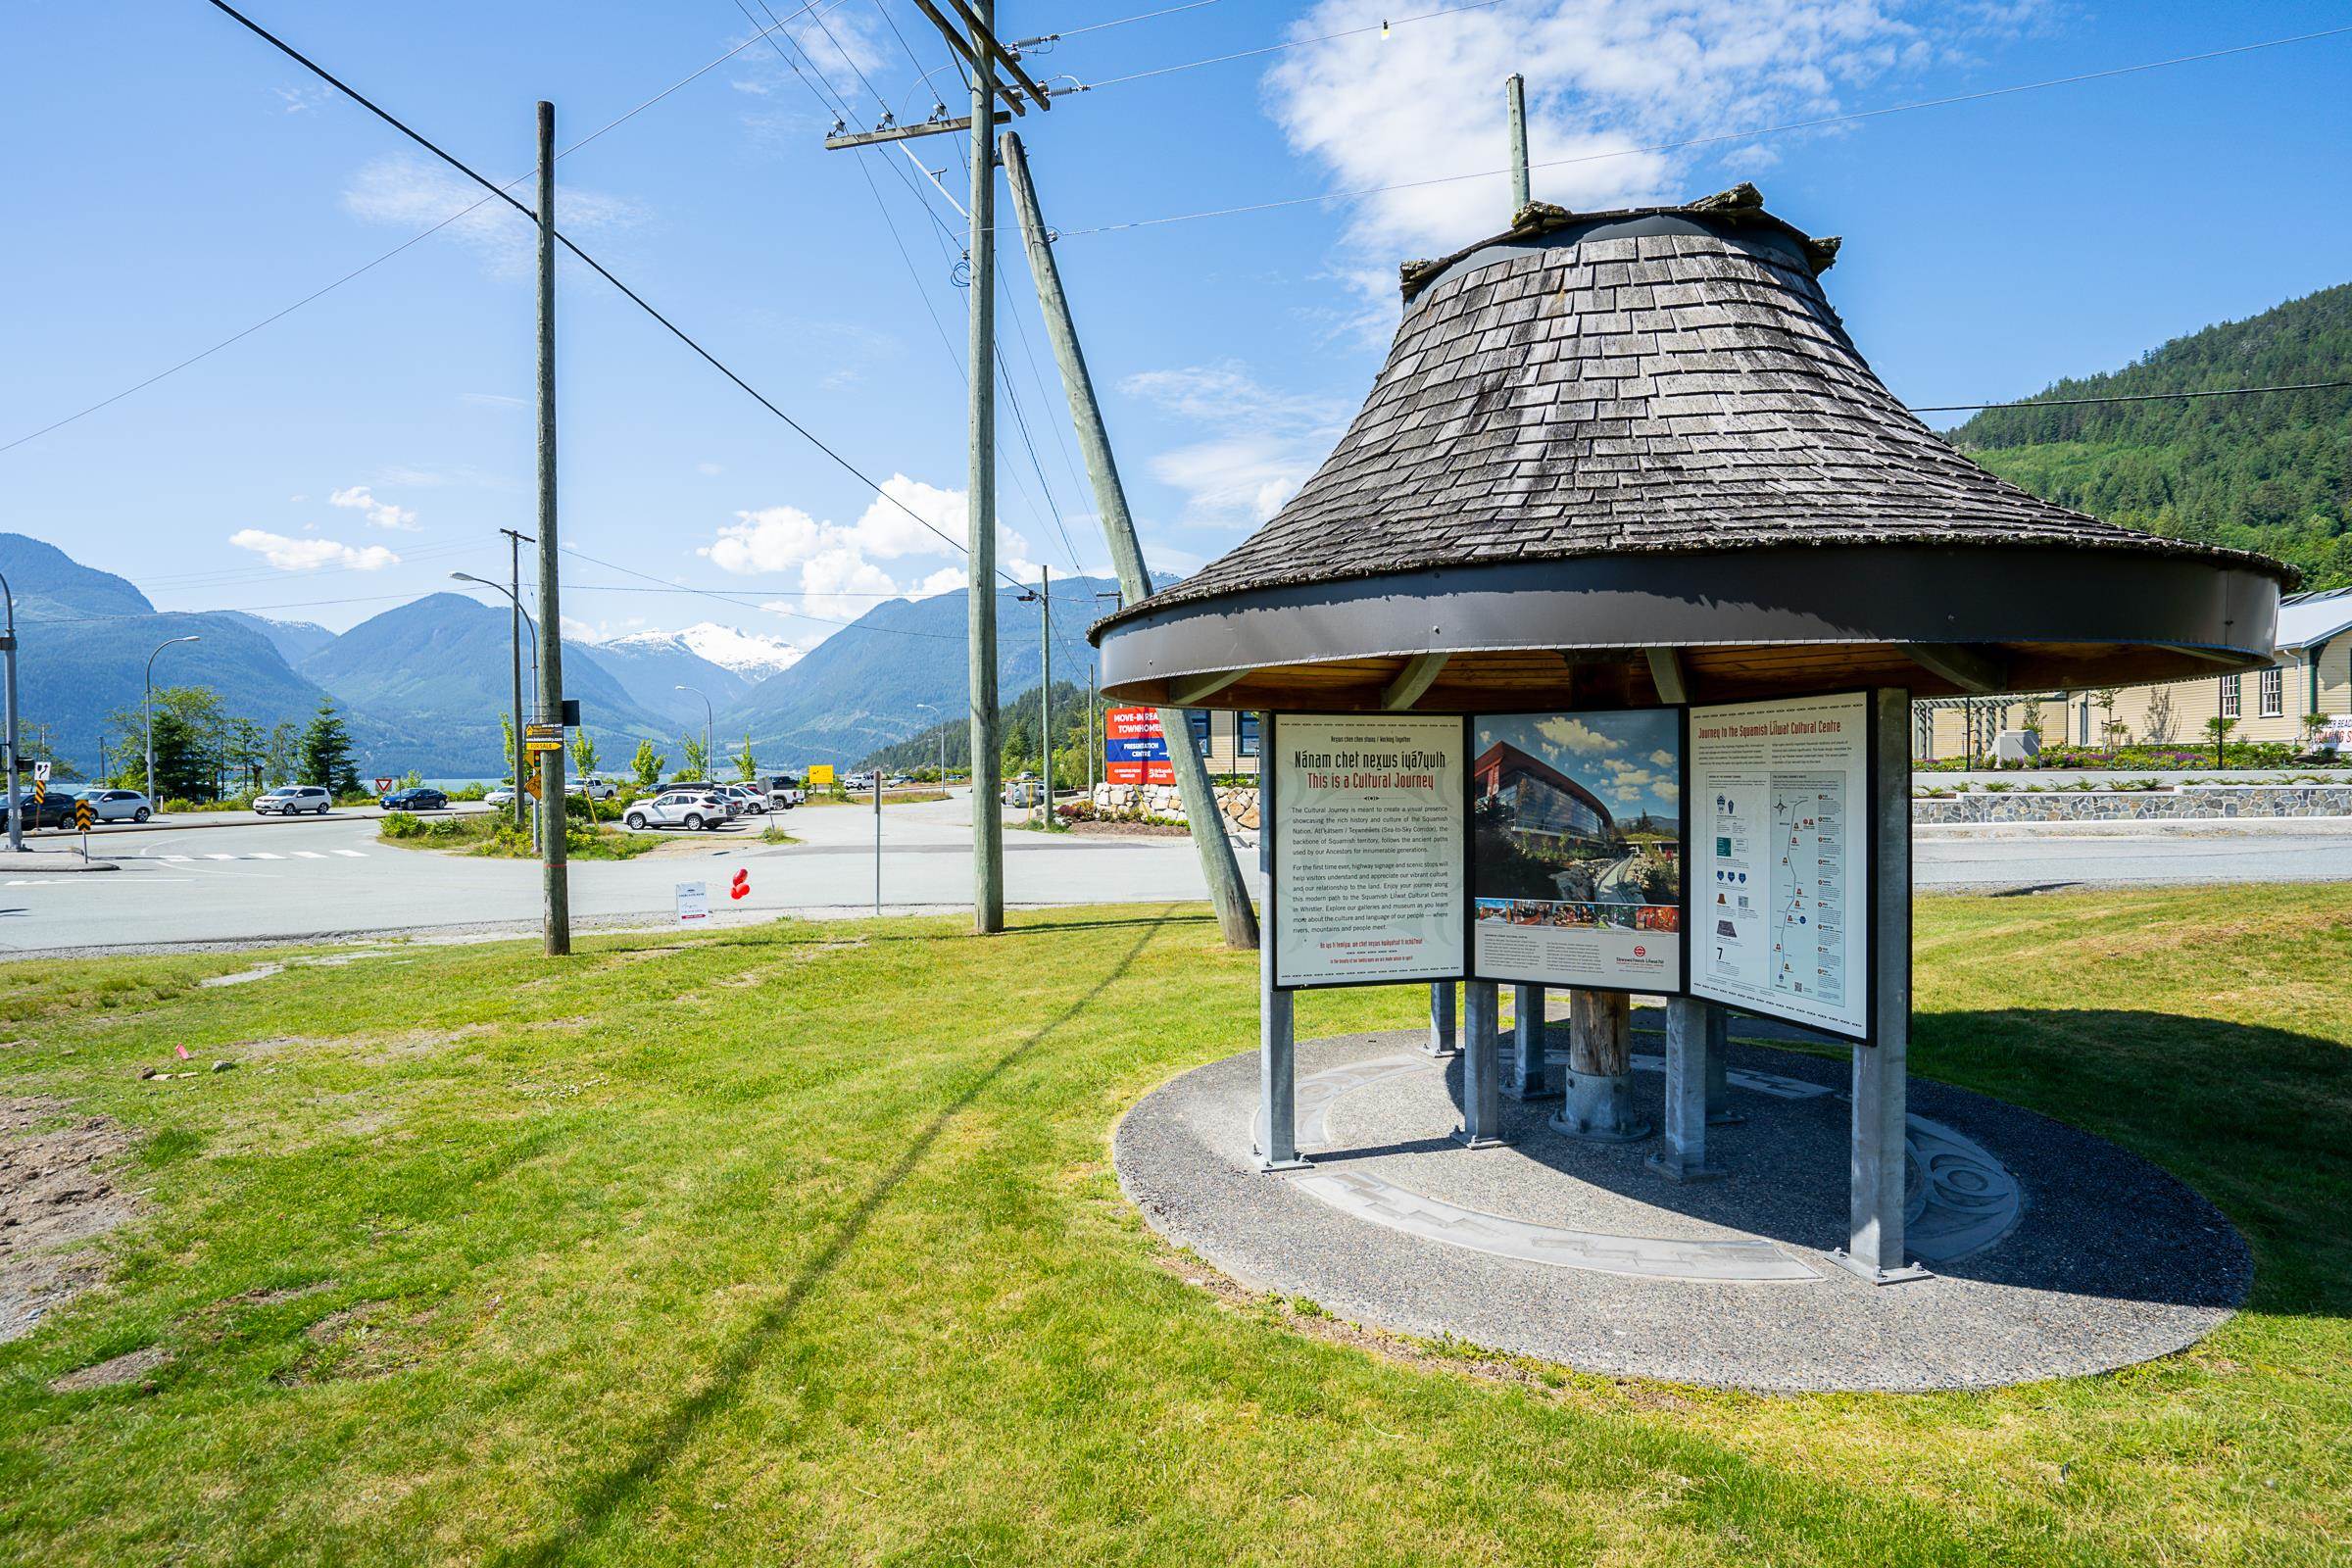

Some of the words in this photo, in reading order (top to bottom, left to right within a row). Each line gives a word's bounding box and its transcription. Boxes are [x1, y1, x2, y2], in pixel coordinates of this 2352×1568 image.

[1114, 712, 1144, 722] MOVE-IN
[1698, 727, 1720, 739] Journey
[1721, 726, 1727, 738] to
[1729, 725, 1738, 737] the
[1740, 724, 1768, 738] Squamish
[1790, 721, 1816, 734] Cultural
[1818, 720, 1840, 733] Centre
[1295, 751, 1331, 767] Nánam
[1336, 751, 1359, 768] chet
[1307, 773, 1327, 788] This
[1332, 773, 1340, 788] is
[1344, 777, 1348, 788] a
[1352, 772, 1391, 788] Cultural
[1395, 772, 1434, 790] Journey
[1717, 947, 1723, 959] 7
